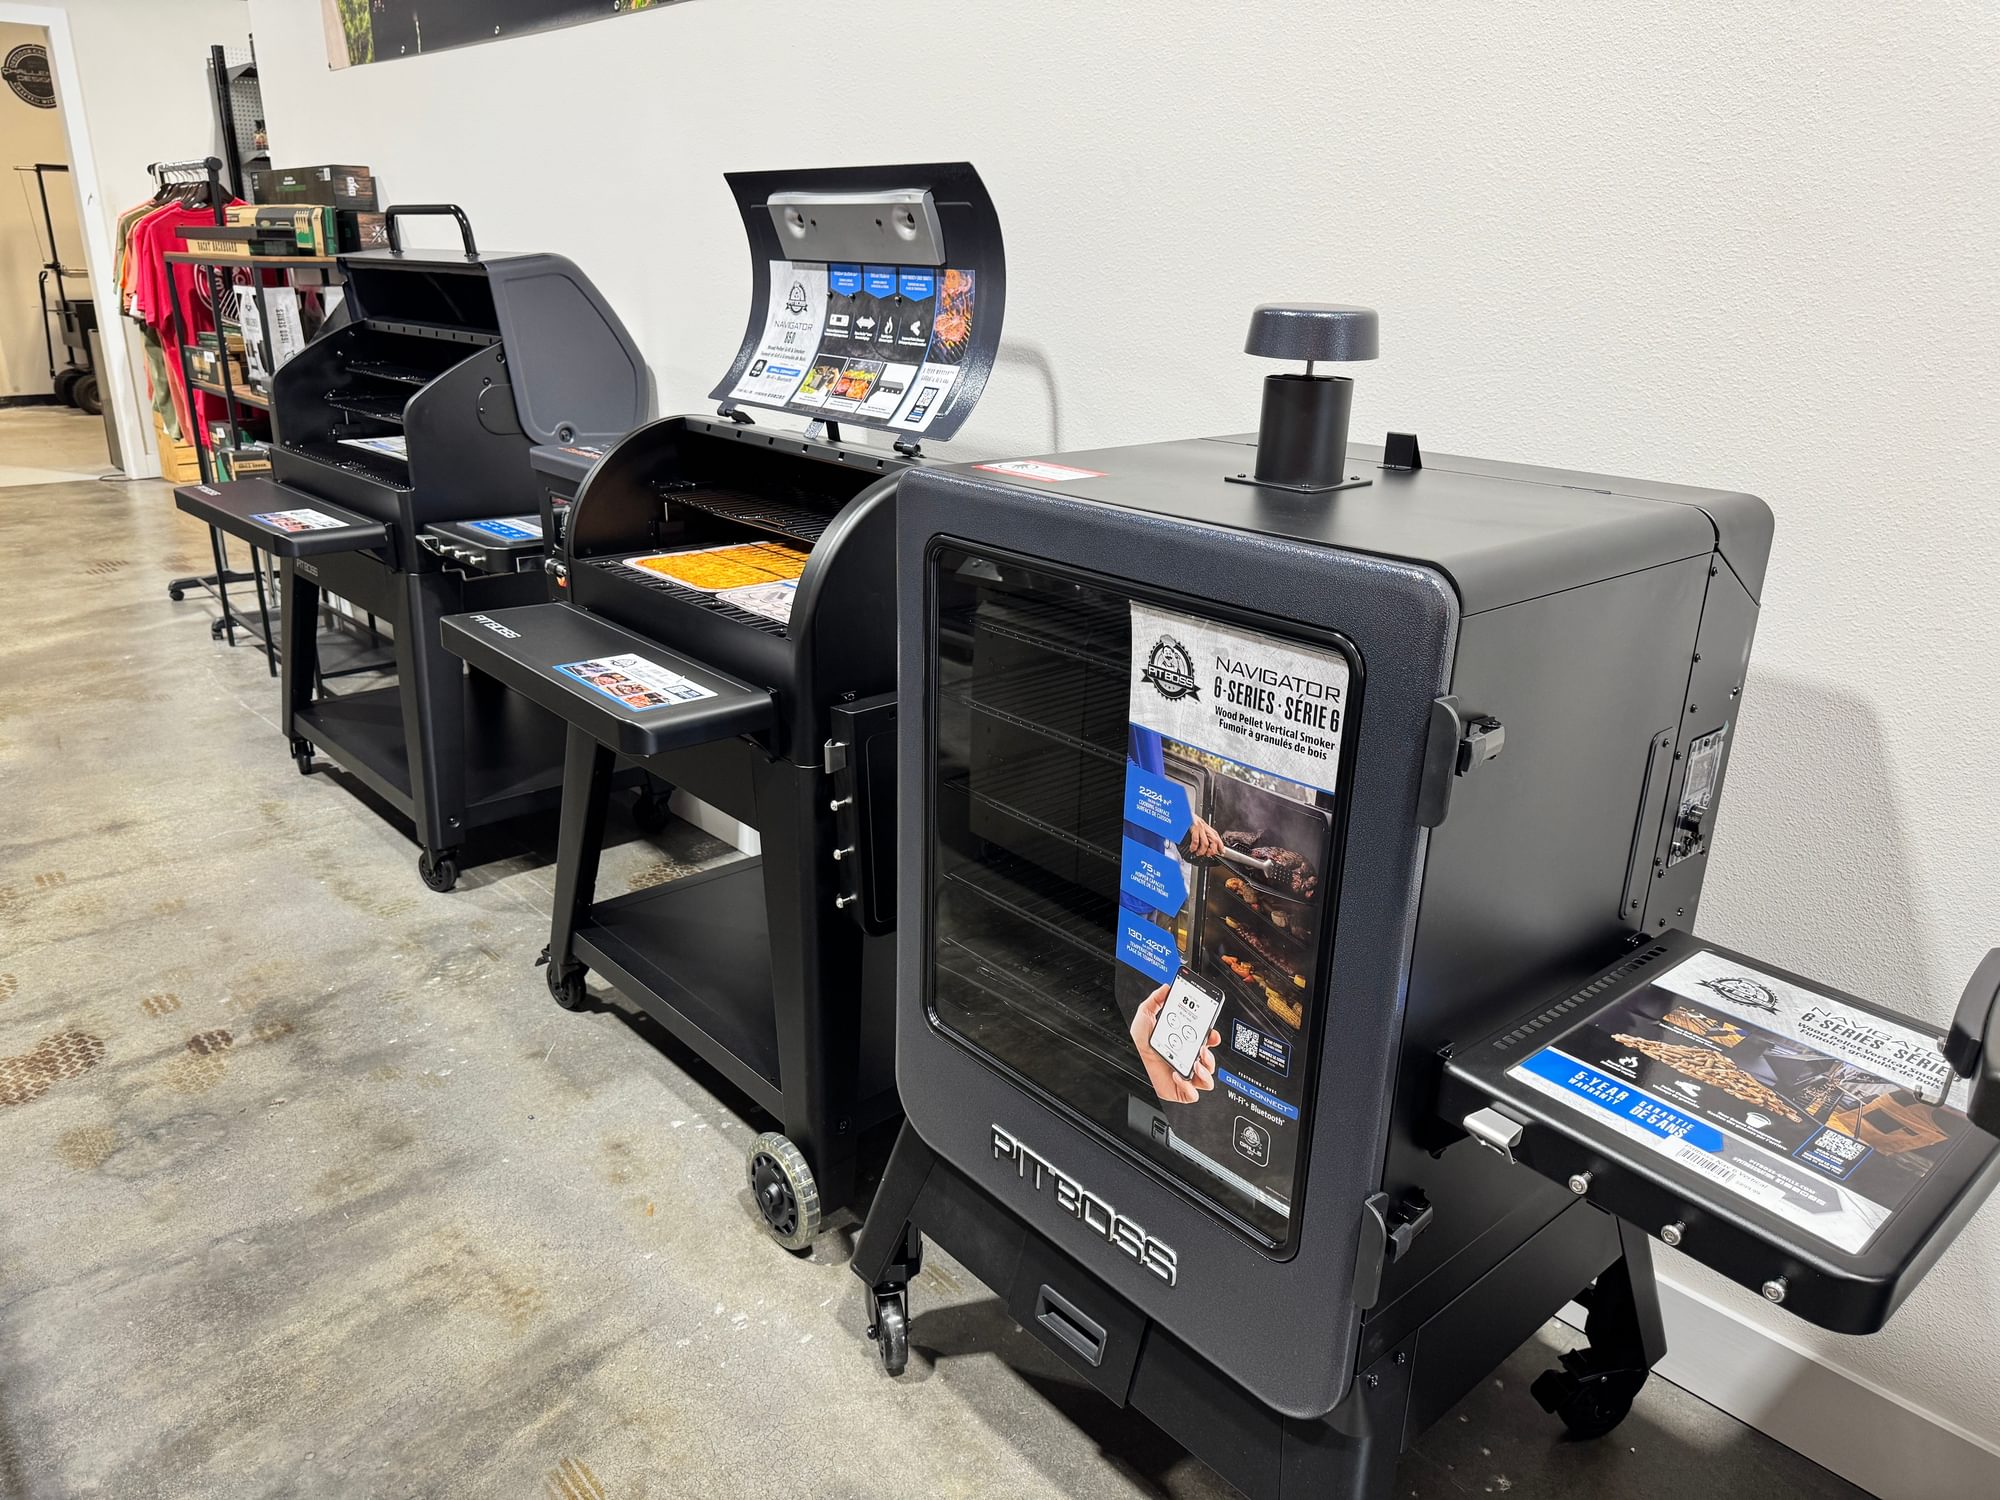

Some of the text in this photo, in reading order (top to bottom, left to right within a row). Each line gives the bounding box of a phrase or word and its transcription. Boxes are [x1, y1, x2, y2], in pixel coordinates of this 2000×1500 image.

[774, 320, 813, 331] NAVIGATOR
[1149, 665, 1194, 688] PIT BOSS
[1216, 656, 1340, 703] NAVIGATOR
[1214, 676, 1340, 733] 6-SERIES SÉRIE 6
[1215, 706, 1335, 750] Wood Pellet Vertical Smoker
[1219, 719, 1327, 760] Fumoir à granulés de bois
[1141, 860, 1153, 873] 75
[1153, 869, 1161, 877] LB
[1798, 1022, 1829, 1038] Wood
[1831, 1035, 1862, 1049] Pellet
[1864, 1048, 1907, 1070] Vertical
[1801, 1012, 1885, 1050] 6-SERIES
[1811, 1006, 1948, 1064] NAVIGATO
[1800, 1028, 1838, 1047] Fumoir
[1848, 1049, 1897, 1072] granulés
[1899, 1069, 1914, 1078] de
[1915, 1075, 1941, 1090] bois
[1226, 1076, 1249, 1093] GRILL
[1568, 1077, 1620, 1105] WARRANTY
[1574, 1071, 1629, 1101] 5-YEAR
[1629, 1105, 1649, 1120] DE
[1655, 1120, 1689, 1138] ANS
[1638, 1100, 1695, 1131] GARANTIE
